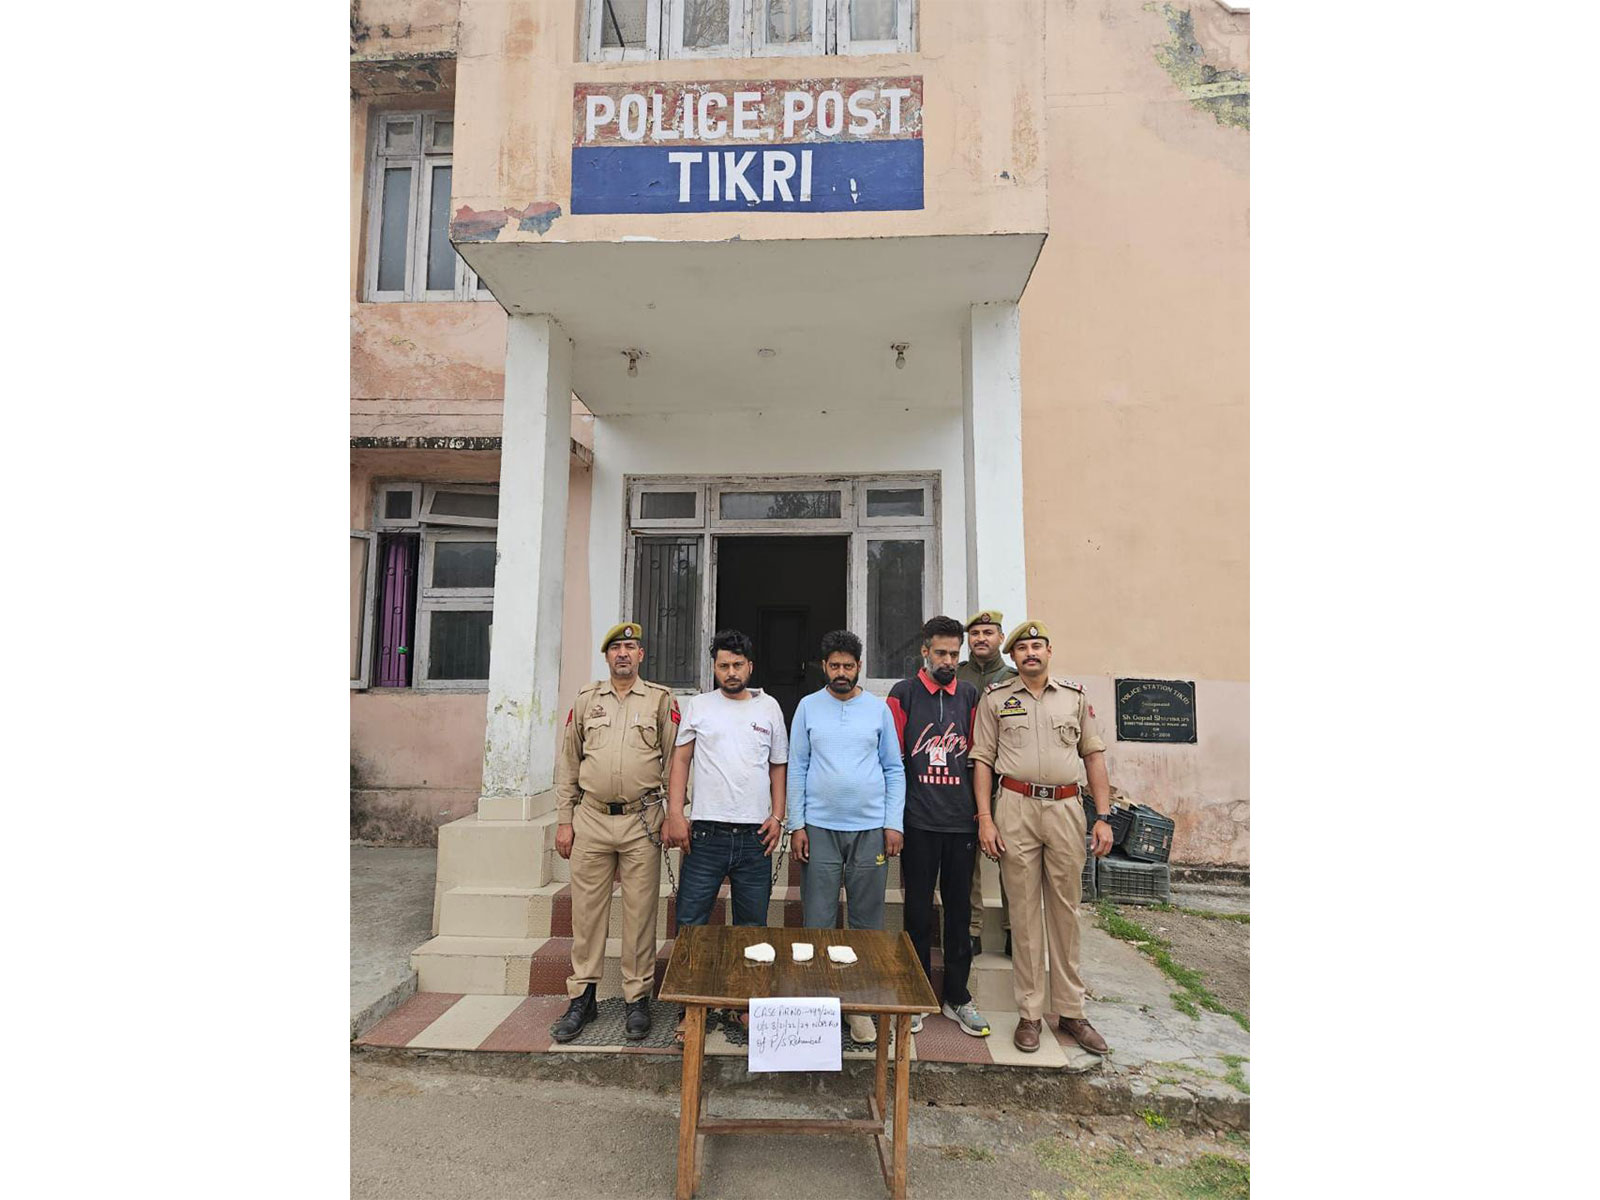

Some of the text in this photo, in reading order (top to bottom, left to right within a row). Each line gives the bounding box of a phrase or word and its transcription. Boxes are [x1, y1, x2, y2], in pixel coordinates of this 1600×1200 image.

[782, 88, 911, 138] POST
[668, 149, 813, 203] TIKRI
[1142, 684, 1173, 692] STATION
[754, 1006, 776, 1018] CASE
